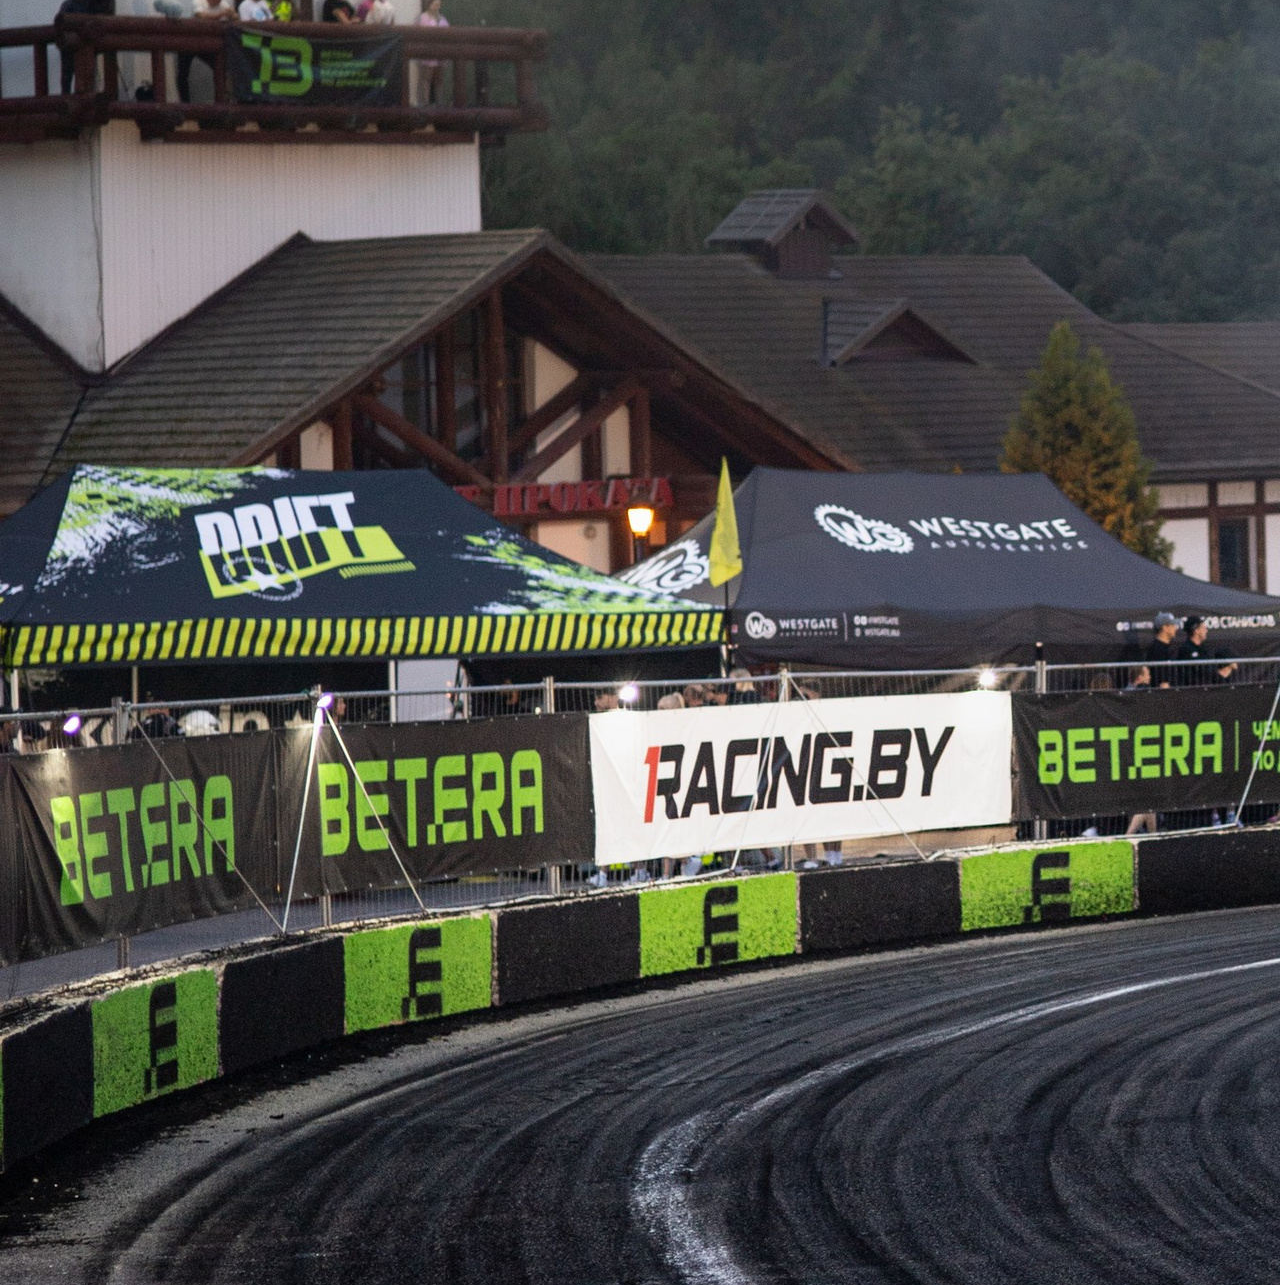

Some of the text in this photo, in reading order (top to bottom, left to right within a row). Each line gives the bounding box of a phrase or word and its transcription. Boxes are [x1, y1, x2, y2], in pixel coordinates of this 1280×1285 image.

[908, 516, 1078, 542] WESTGATE
[778, 617, 838, 630] WESTGATE
[1252, 749, 1274, 771] ПО
